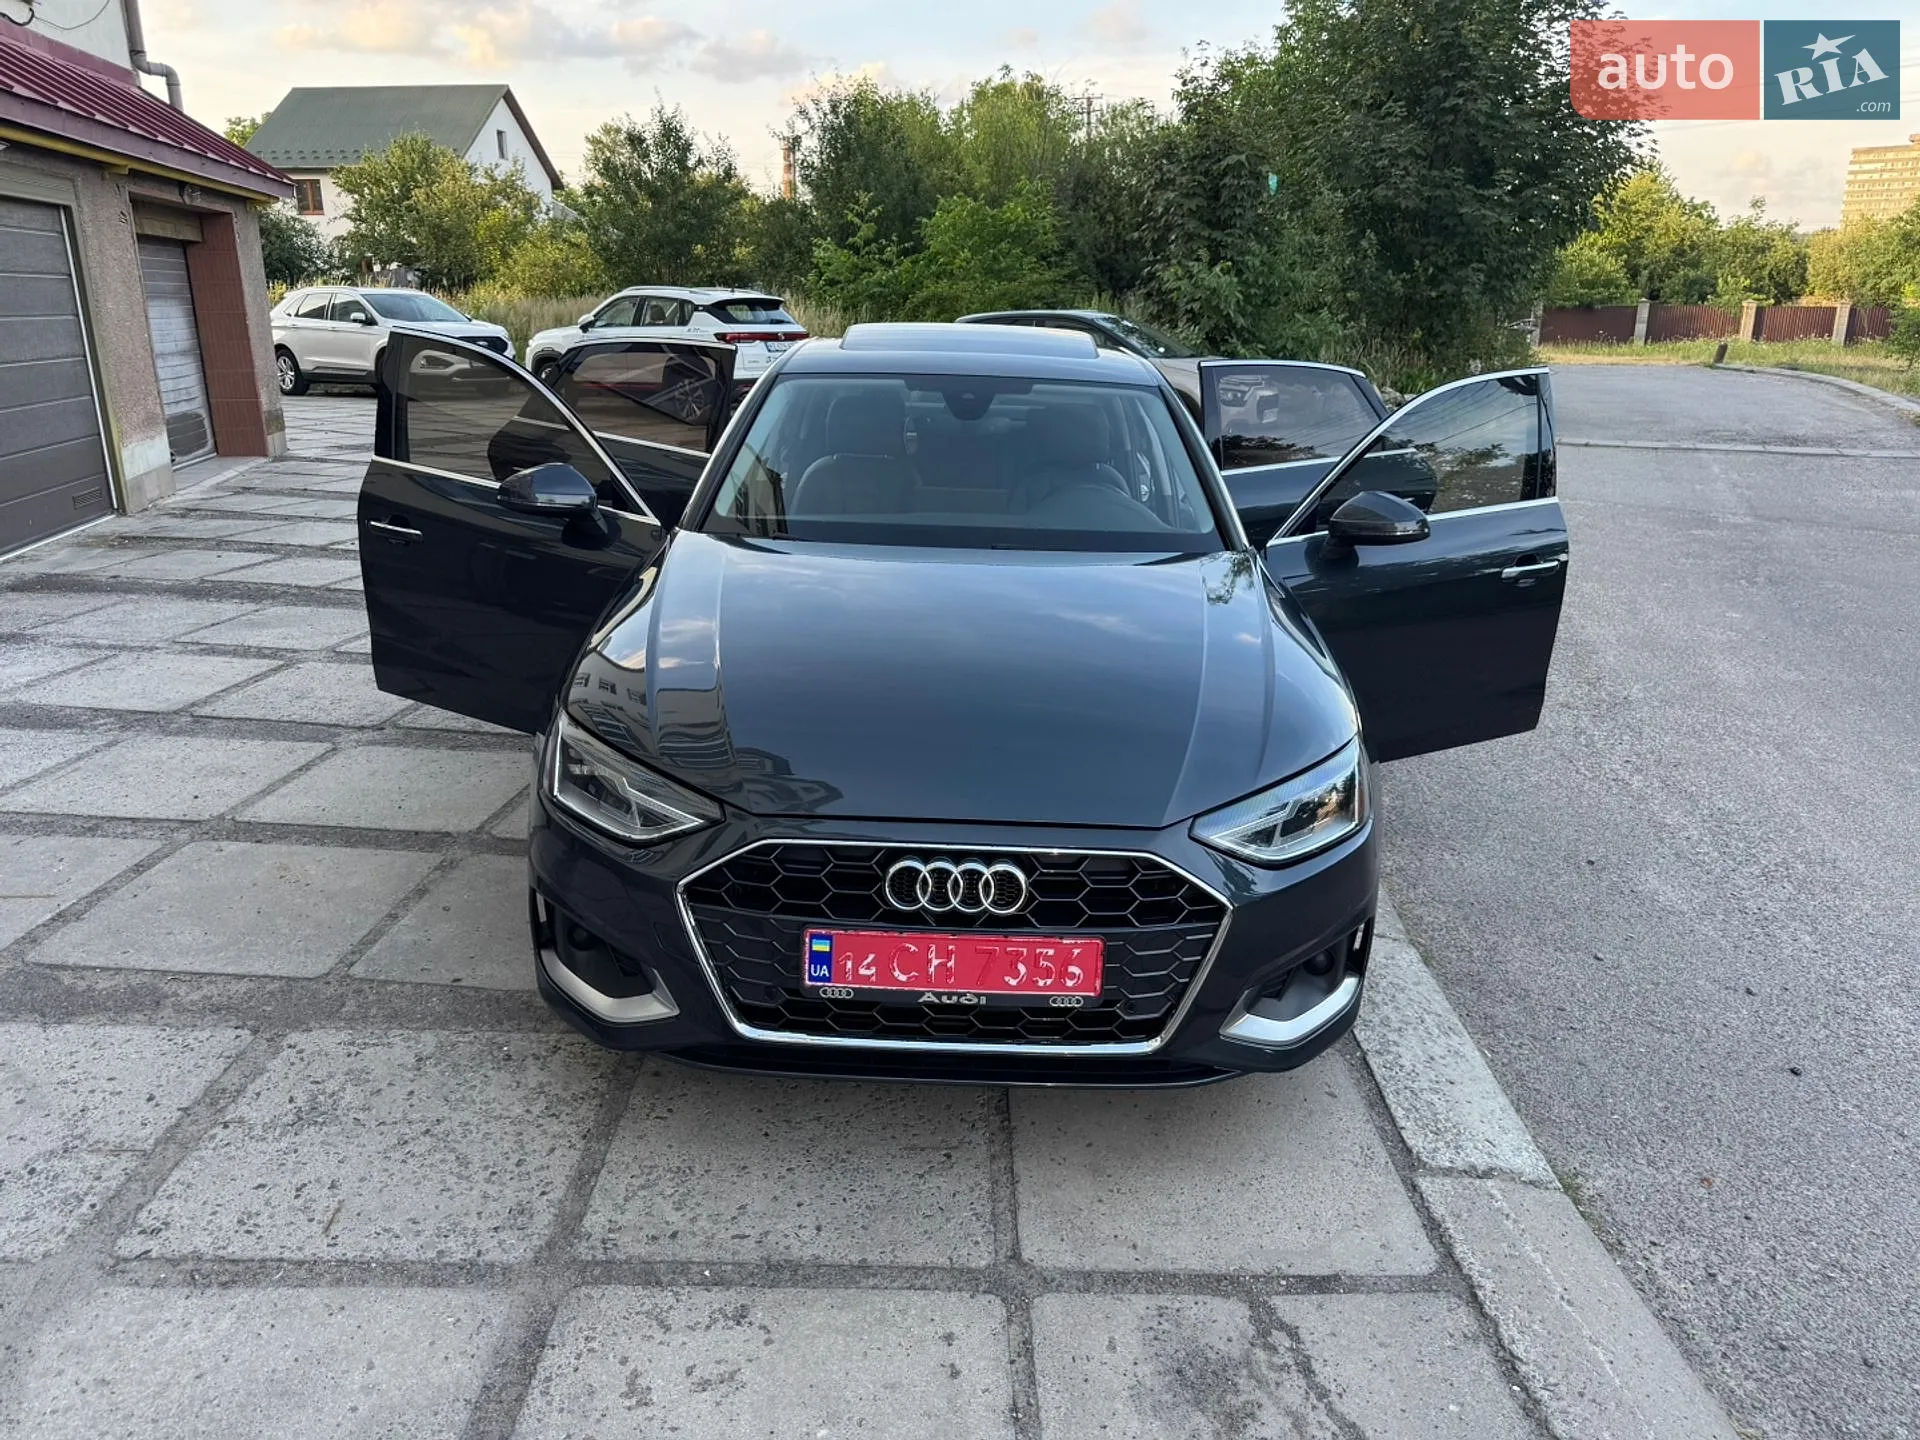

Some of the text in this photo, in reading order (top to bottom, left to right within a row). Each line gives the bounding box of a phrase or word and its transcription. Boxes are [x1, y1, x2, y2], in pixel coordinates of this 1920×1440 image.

[810, 965, 830, 978] UA
[838, 942, 1085, 987] 14 CH 7356
[917, 991, 987, 1005] Audi
